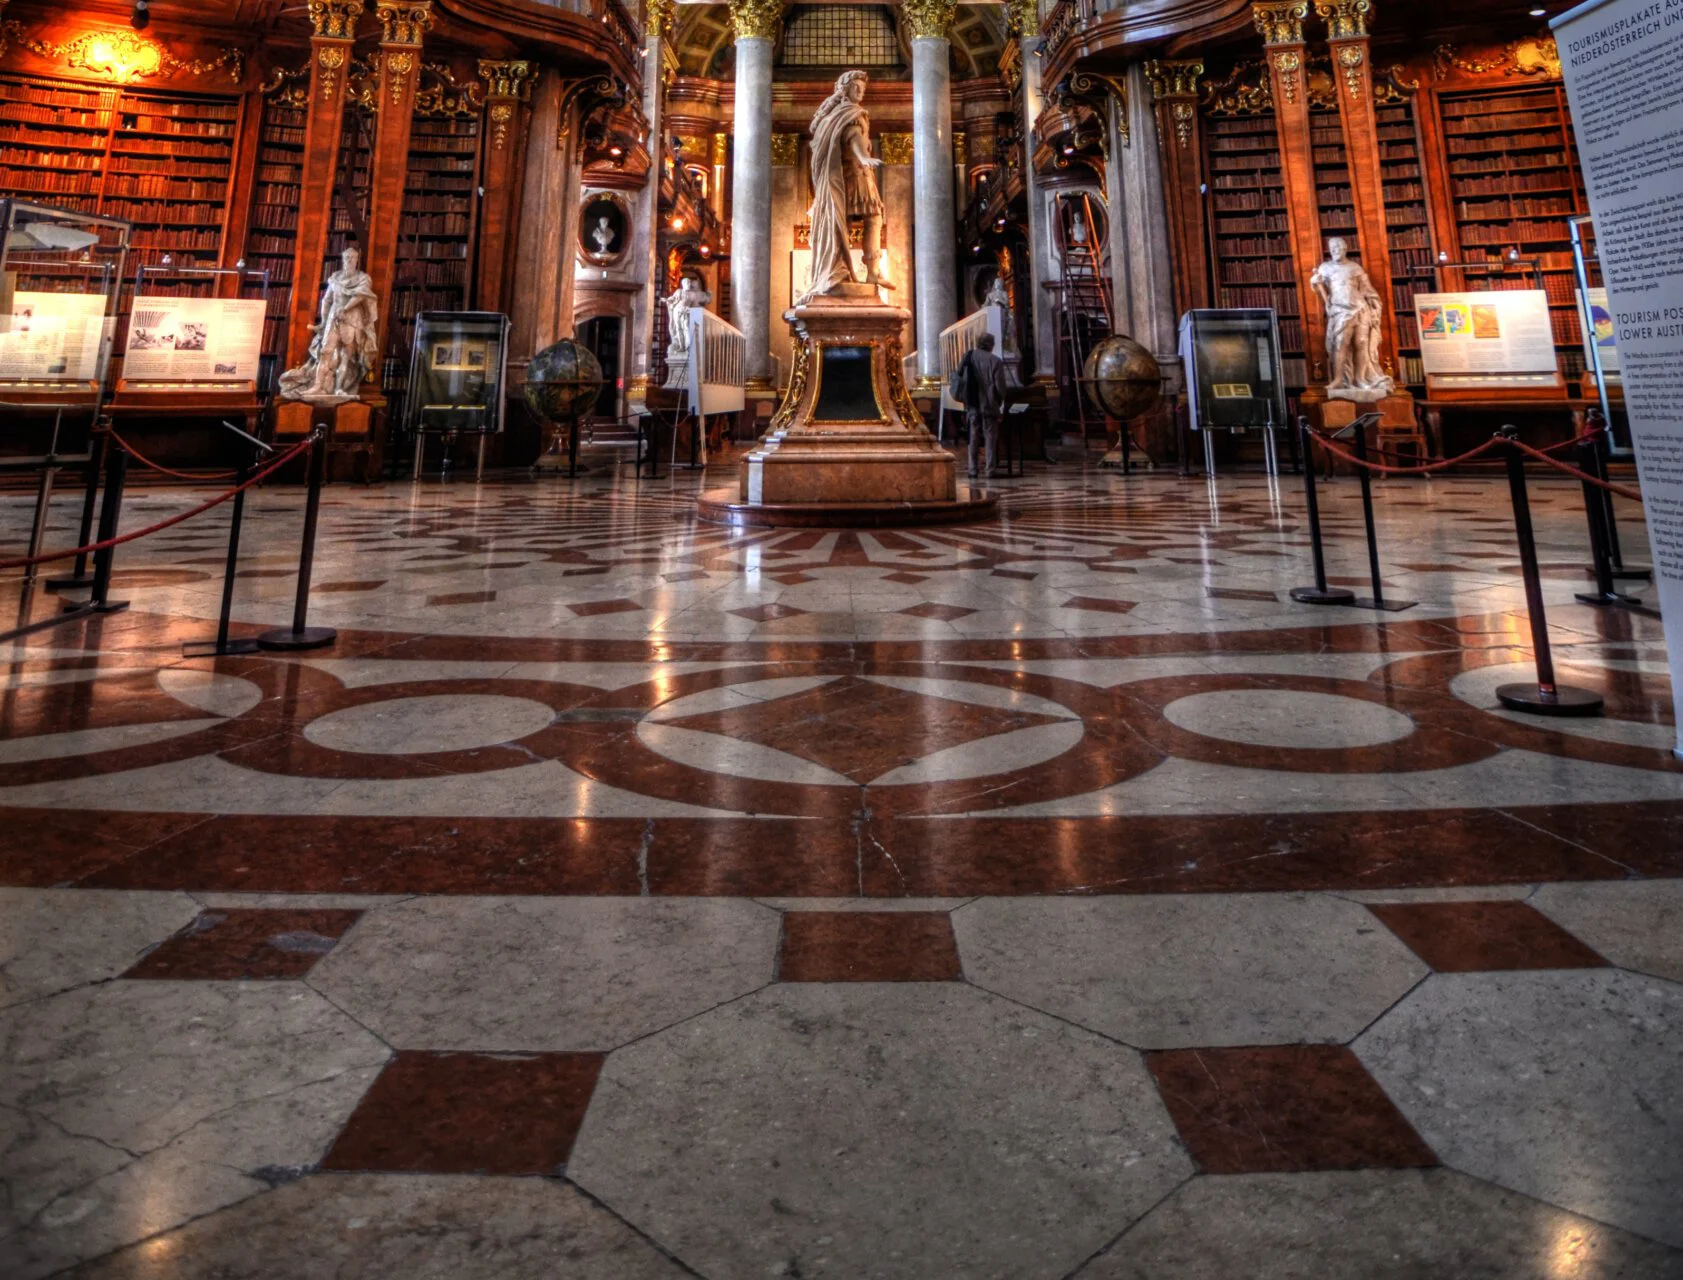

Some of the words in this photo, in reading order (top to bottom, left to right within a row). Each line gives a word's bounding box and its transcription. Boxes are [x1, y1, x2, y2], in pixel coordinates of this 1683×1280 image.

[1567, 2, 1661, 54] TOURISMUSPLAKATE
[1569, 16, 1660, 68] NIEDERÖSTERREICH
[1616, 309, 1660, 324] TOURISM
[1618, 326, 1653, 340] LOWER
[1655, 323, 1683, 337] AUST
